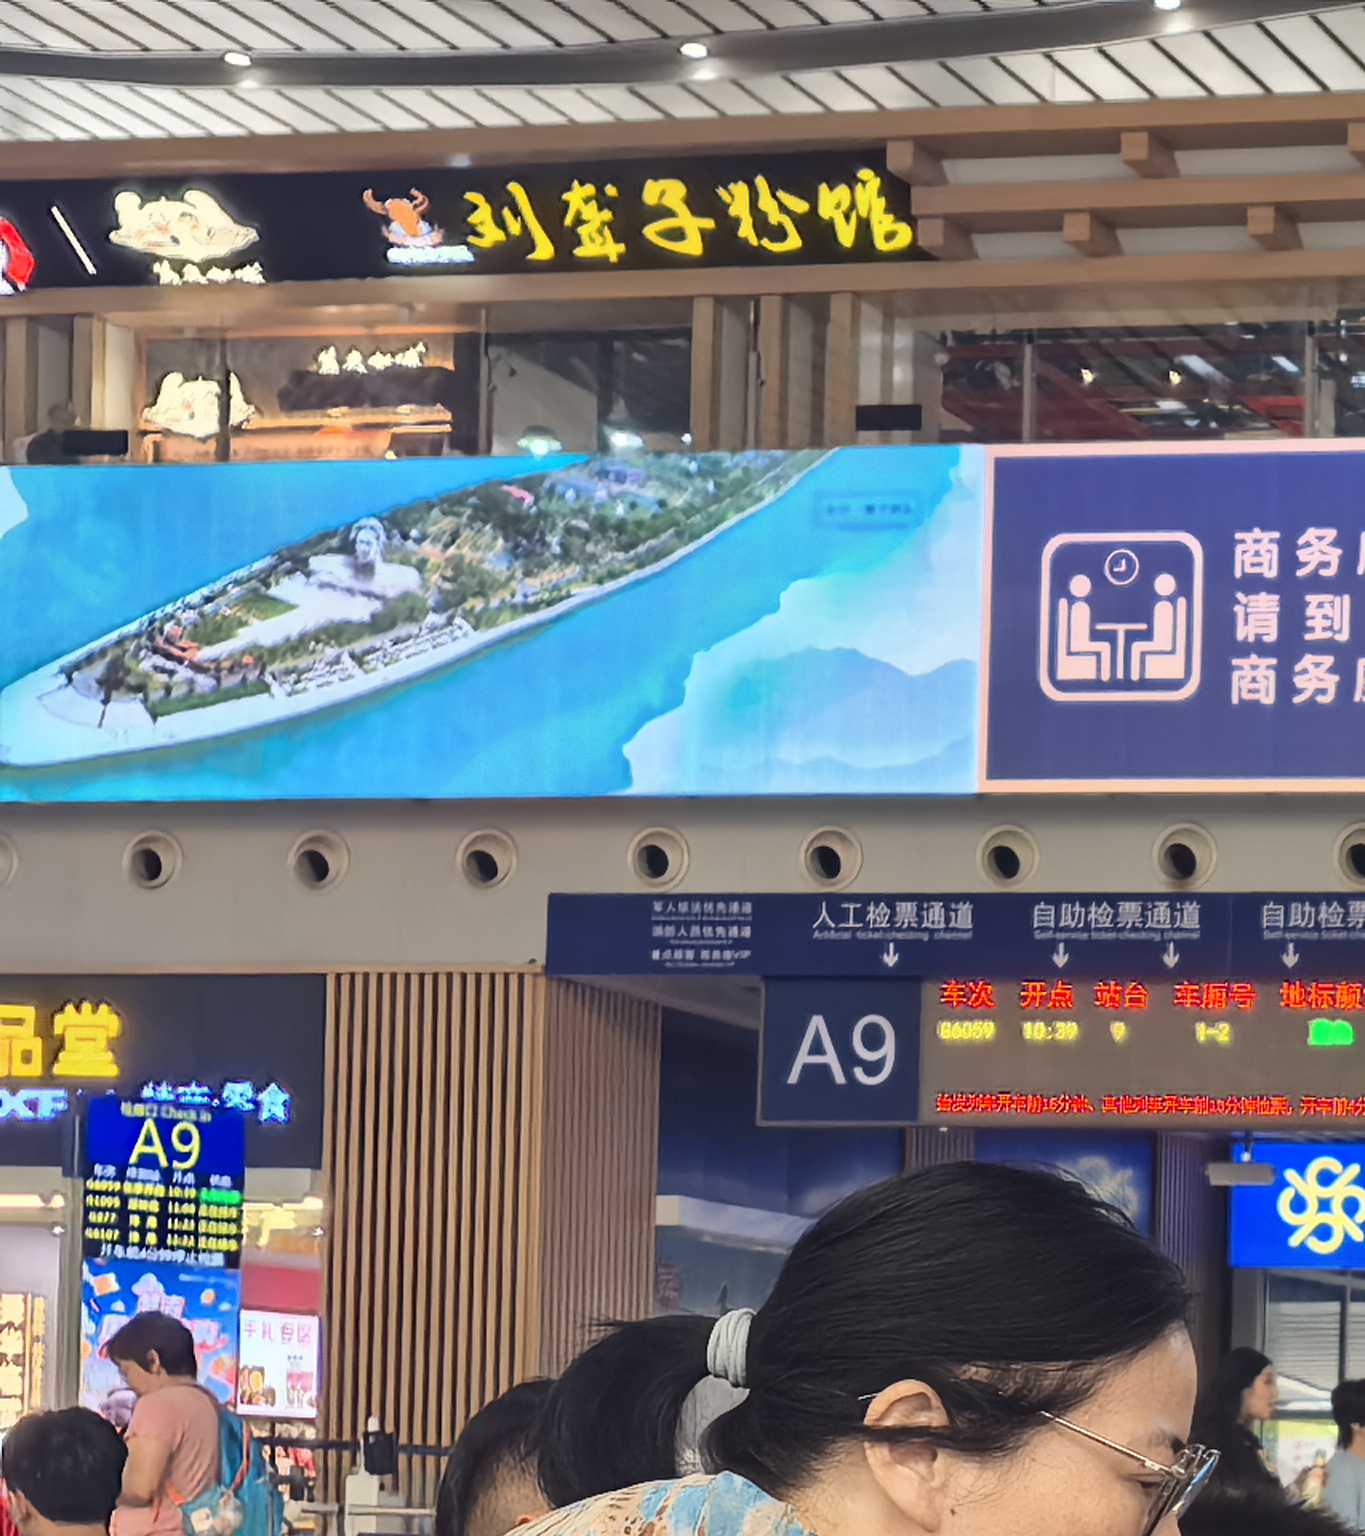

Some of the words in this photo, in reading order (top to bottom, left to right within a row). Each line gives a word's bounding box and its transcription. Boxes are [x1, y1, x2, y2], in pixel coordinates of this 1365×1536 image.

[812, 901, 974, 929] 人工检票通道
[1032, 900, 1201, 929] 自助检票通道
[940, 980, 996, 1009] 车次
[1019, 980, 1075, 1009] 开点
[1094, 980, 1149, 1009] 站台
[1174, 981, 1256, 1010] 车厢号
[787, 1014, 897, 1085] A9
[129, 1118, 200, 1170] A9
